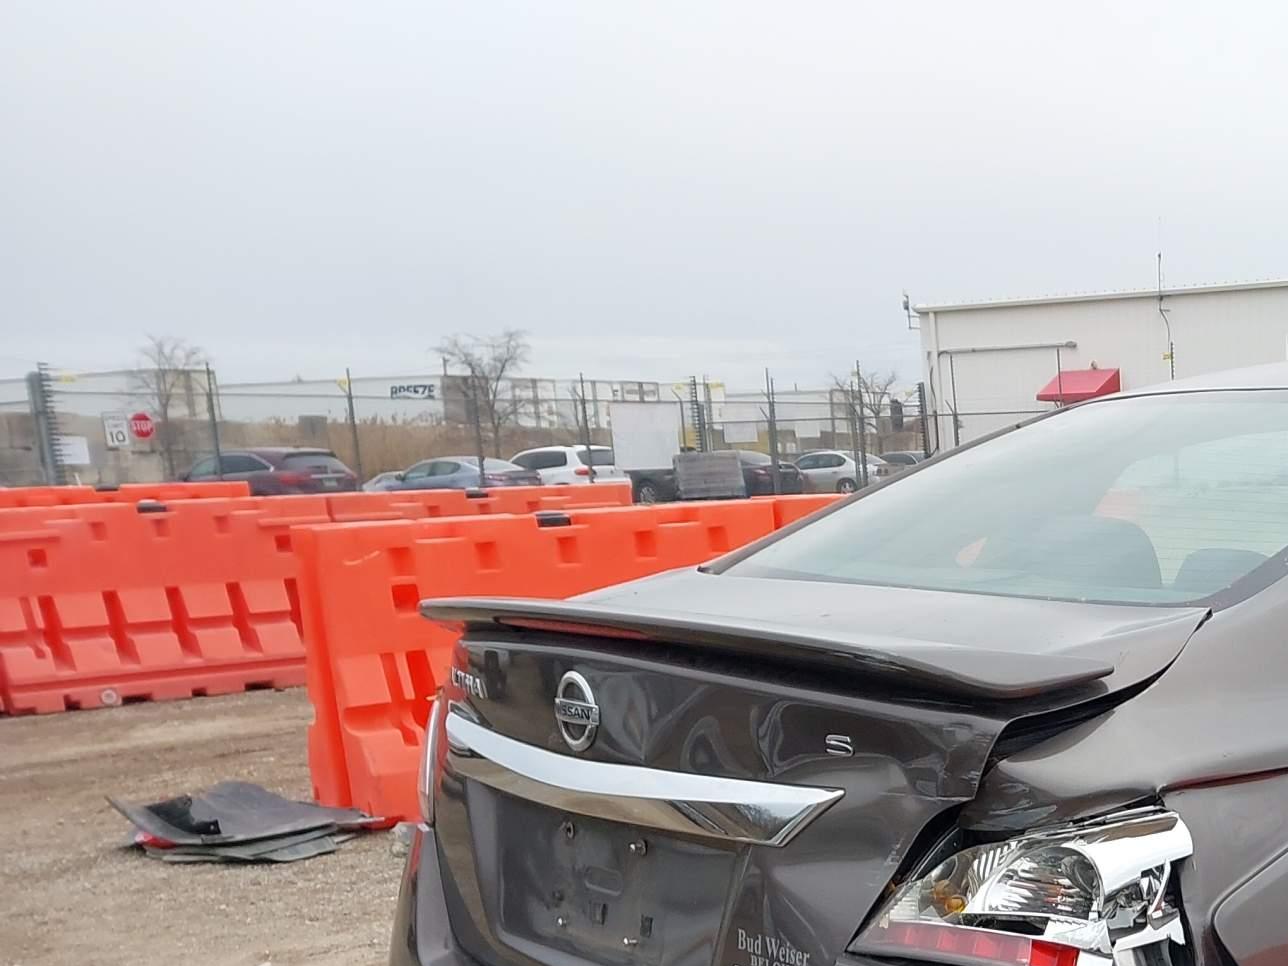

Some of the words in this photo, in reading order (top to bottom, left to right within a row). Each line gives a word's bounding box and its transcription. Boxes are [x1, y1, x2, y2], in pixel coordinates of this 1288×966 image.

[131, 420, 155, 433] STOP
[110, 430, 126, 443] 10
[825, 734, 853, 757] S
[738, 927, 762, 955] Bud
